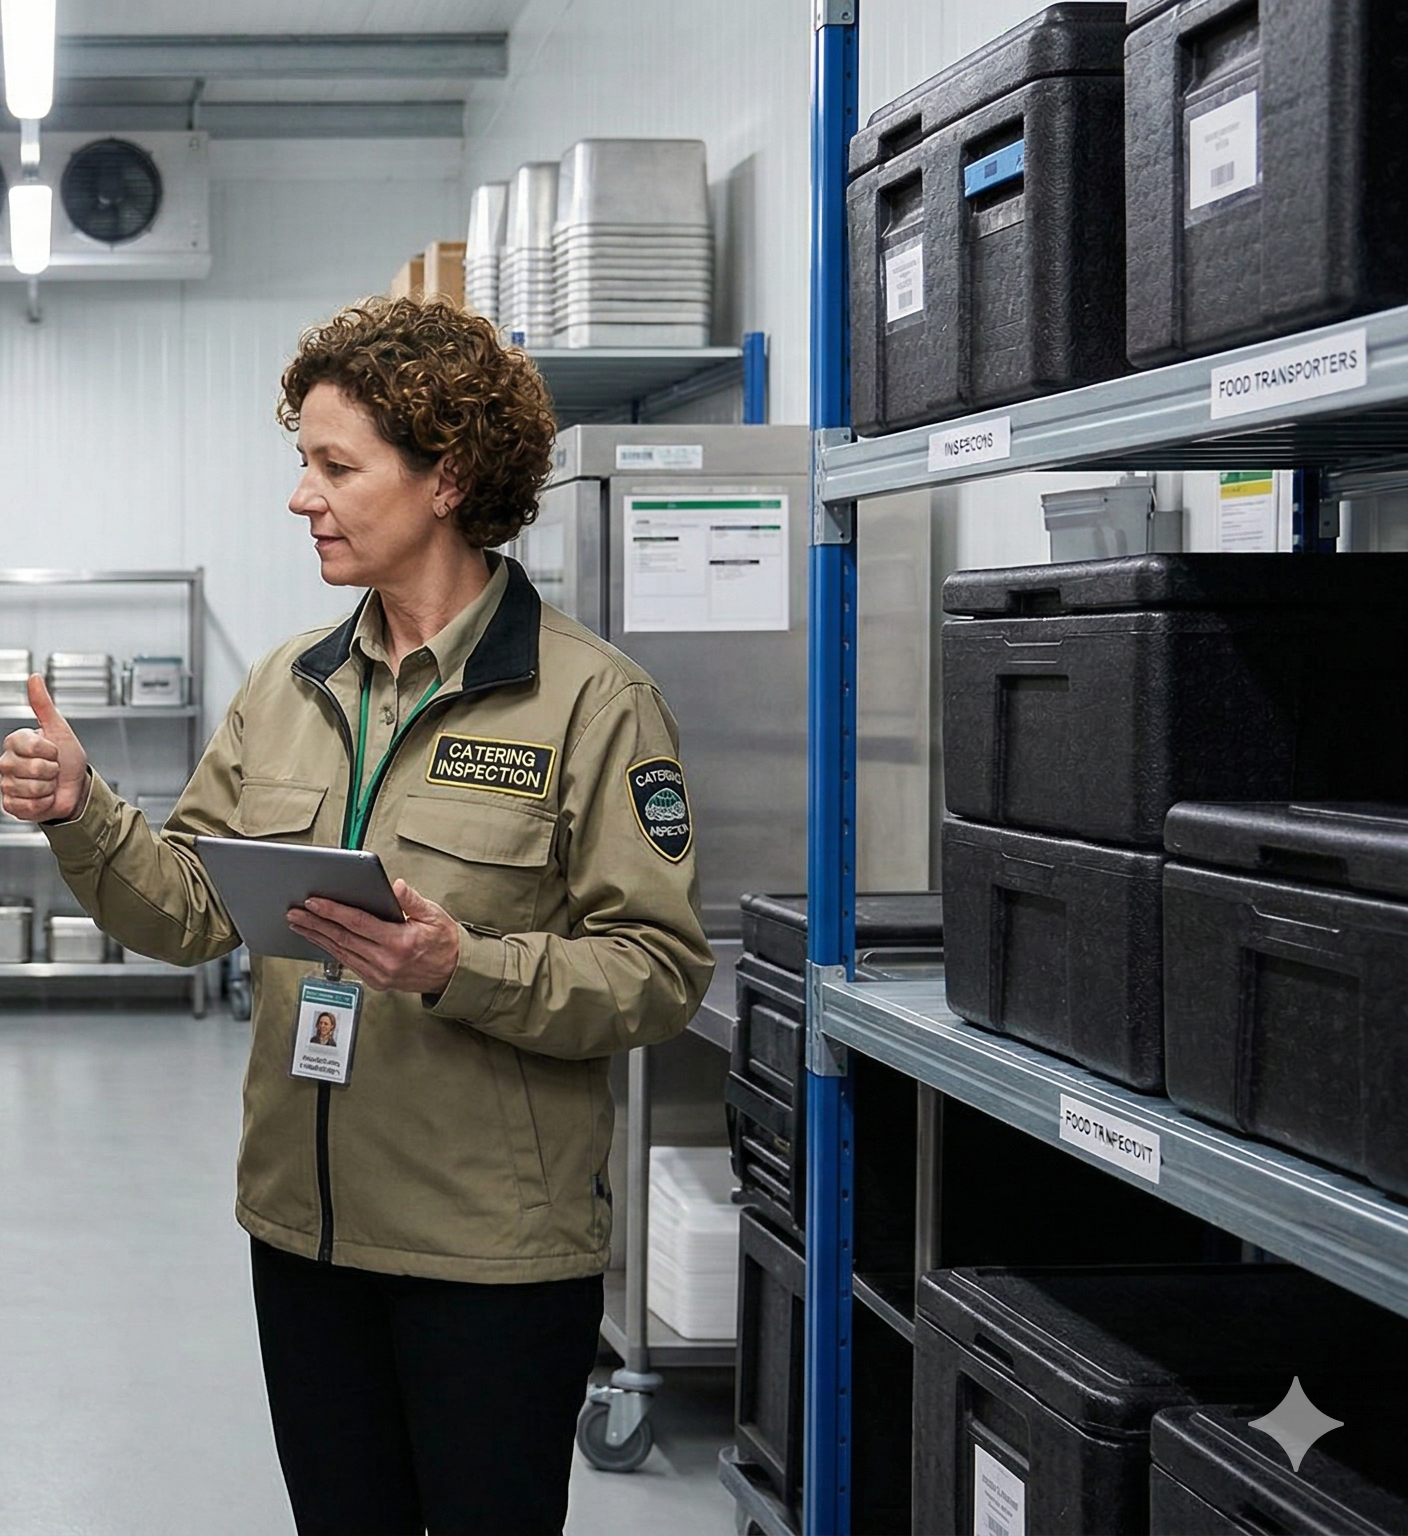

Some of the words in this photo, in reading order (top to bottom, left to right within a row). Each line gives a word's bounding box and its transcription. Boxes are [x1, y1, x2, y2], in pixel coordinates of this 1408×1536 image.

[1219, 375, 1251, 399] FOOD
[1254, 350, 1358, 391] TRANSPORTERS
[448, 743, 537, 767] CATERING
[435, 759, 541, 788] INSPECTION
